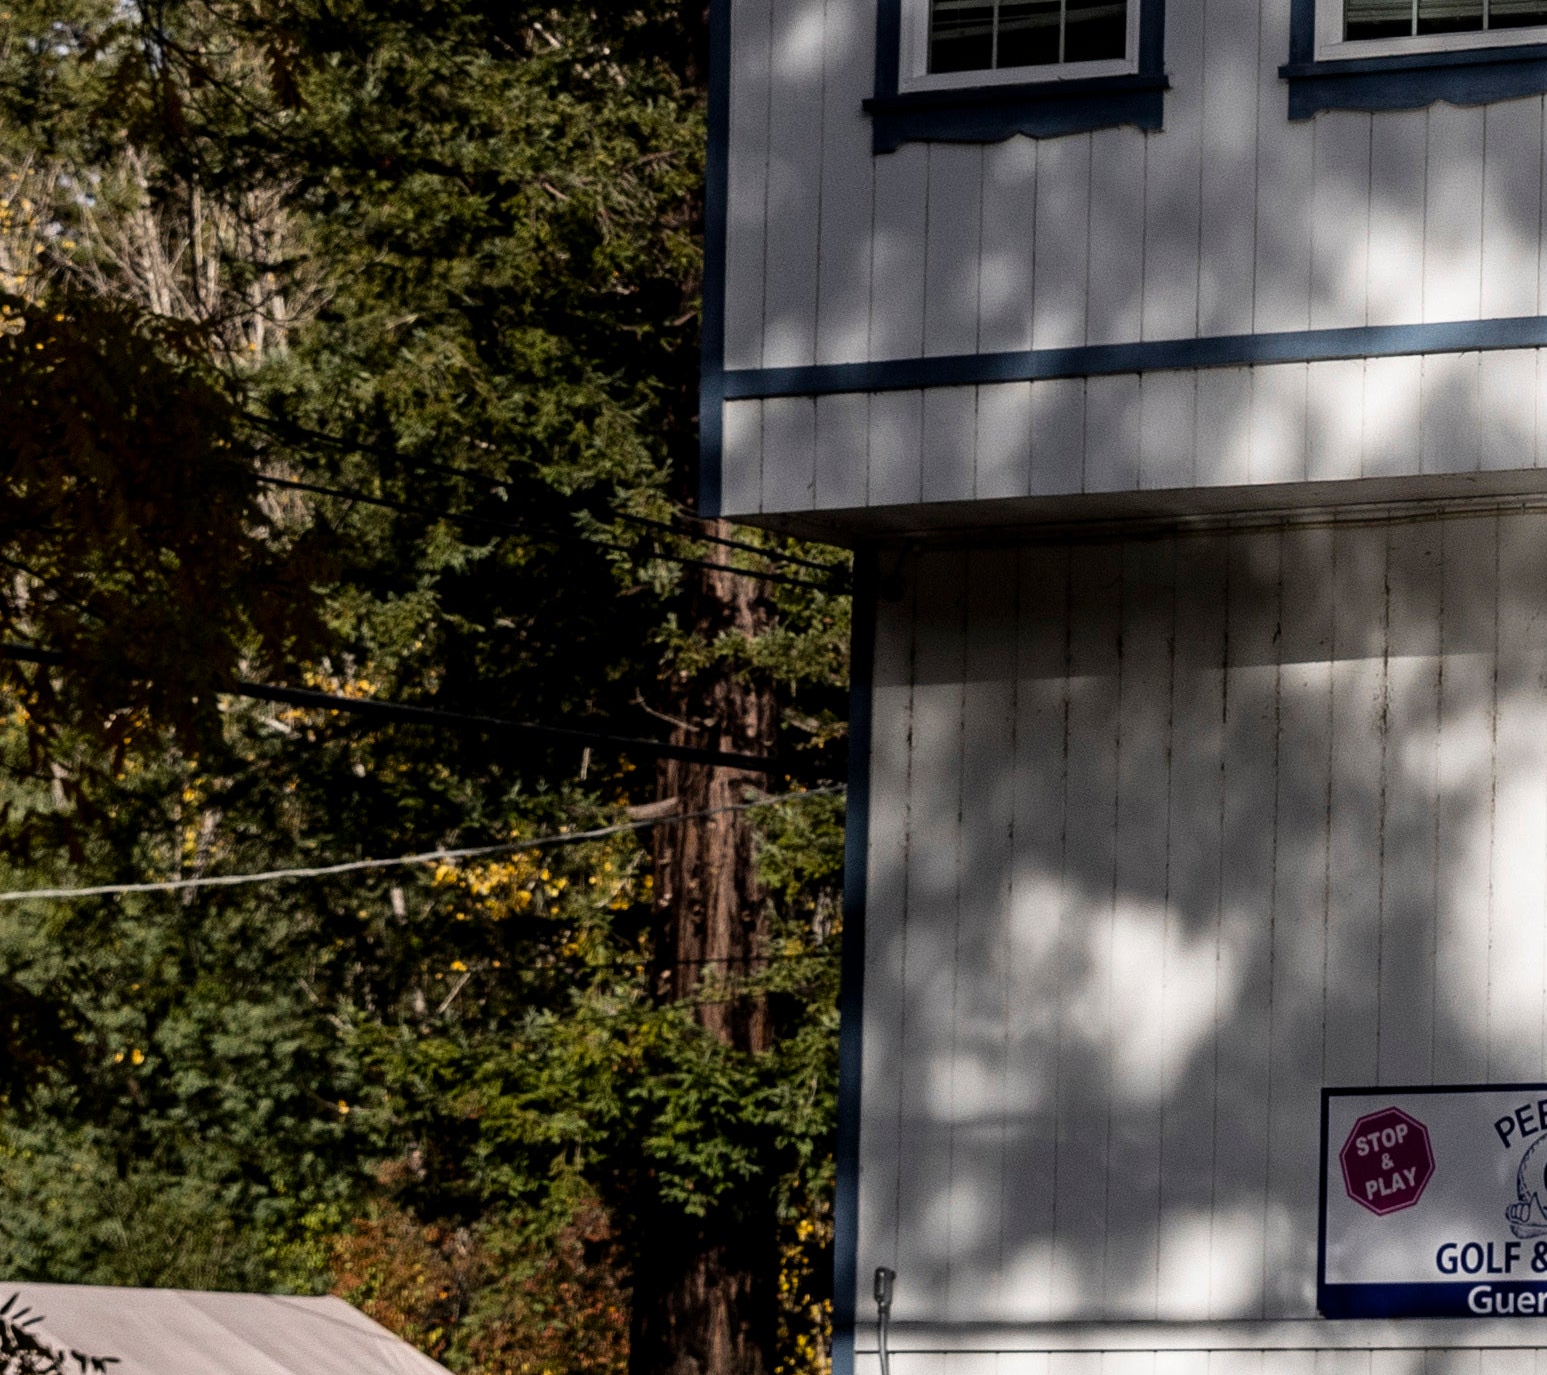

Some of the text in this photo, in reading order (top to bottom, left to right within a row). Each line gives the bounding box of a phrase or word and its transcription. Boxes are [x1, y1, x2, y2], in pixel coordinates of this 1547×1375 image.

[1354, 1122, 1410, 1156] STOP
[1380, 1153, 1395, 1169] &
[1364, 1166, 1418, 1201] PLAY
[1435, 1240, 1521, 1275] GOLF
